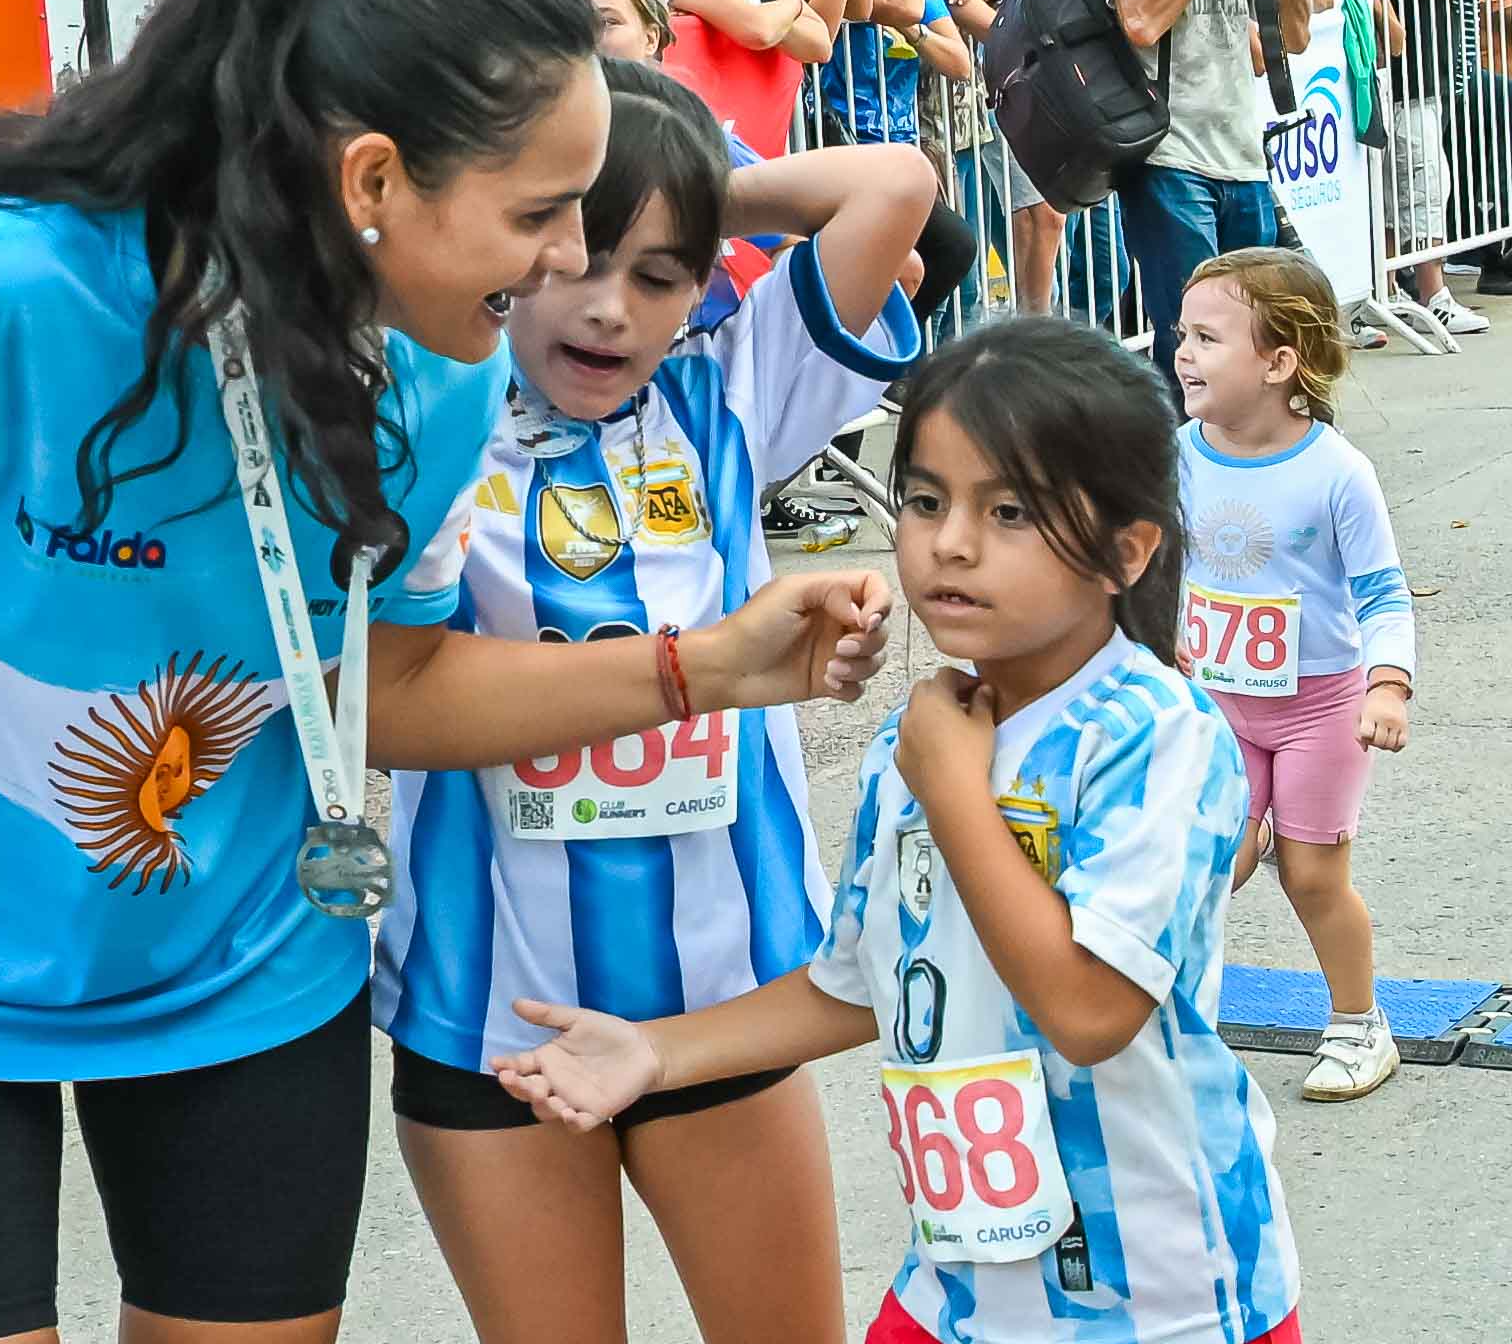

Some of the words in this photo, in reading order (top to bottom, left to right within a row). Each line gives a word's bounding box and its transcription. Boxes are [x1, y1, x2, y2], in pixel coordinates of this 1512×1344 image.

[1266, 112, 1339, 184] RUSO
[1244, 676, 1289, 688] CARUSO
[665, 794, 727, 817] CARUSO
[976, 1219, 1052, 1244] CARUSO
